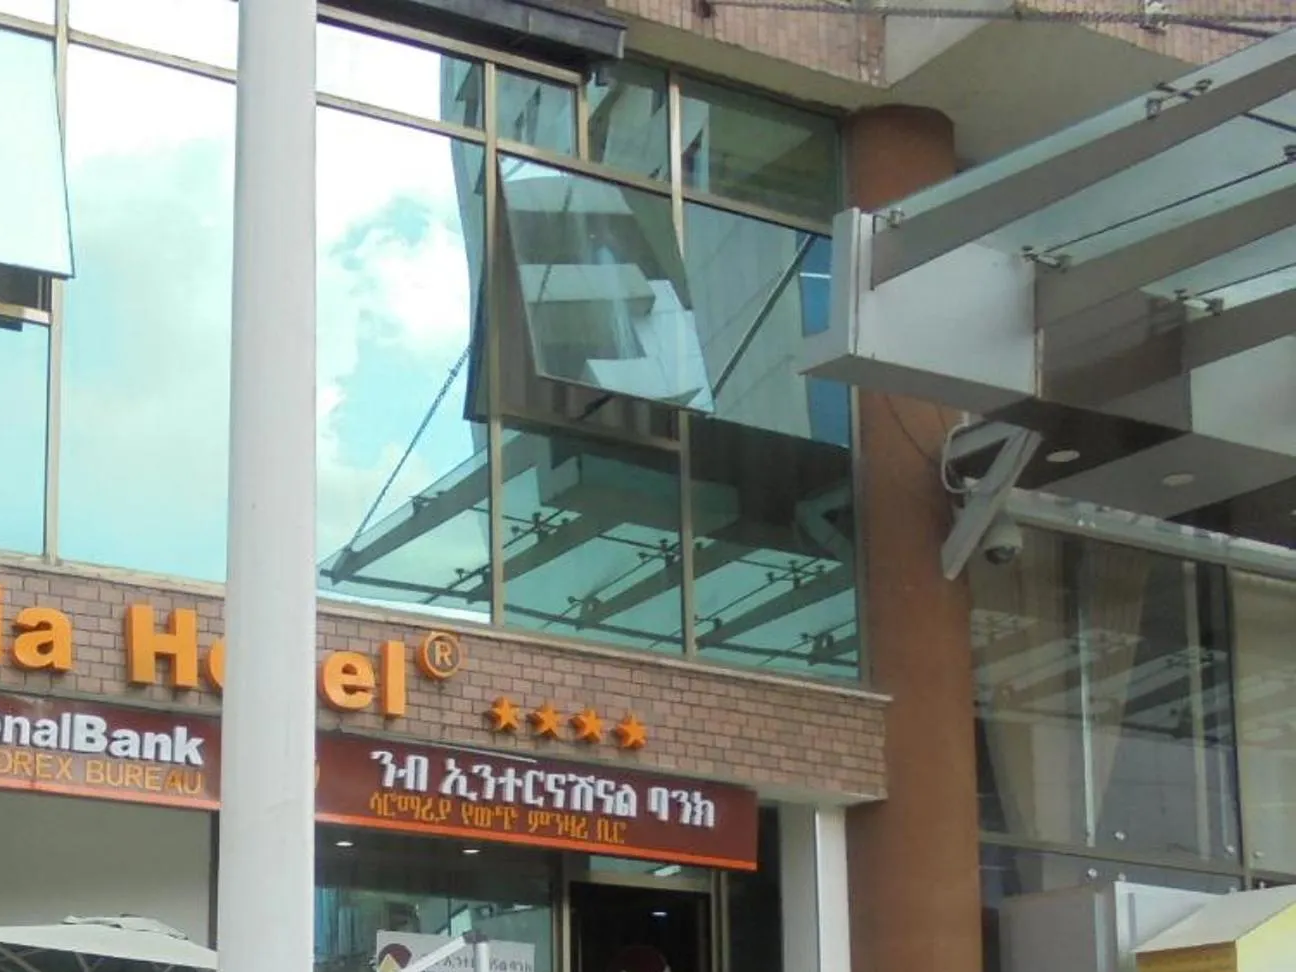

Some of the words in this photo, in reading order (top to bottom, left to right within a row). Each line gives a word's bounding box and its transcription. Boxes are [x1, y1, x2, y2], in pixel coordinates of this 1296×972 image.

[124, 602, 407, 717] Hel
[86, 759, 203, 795] BUREAU
[369, 750, 430, 793] ንብ
[438, 758, 638, 818] ኢንተርናሽናል
[647, 786, 716, 829] ባንክ
